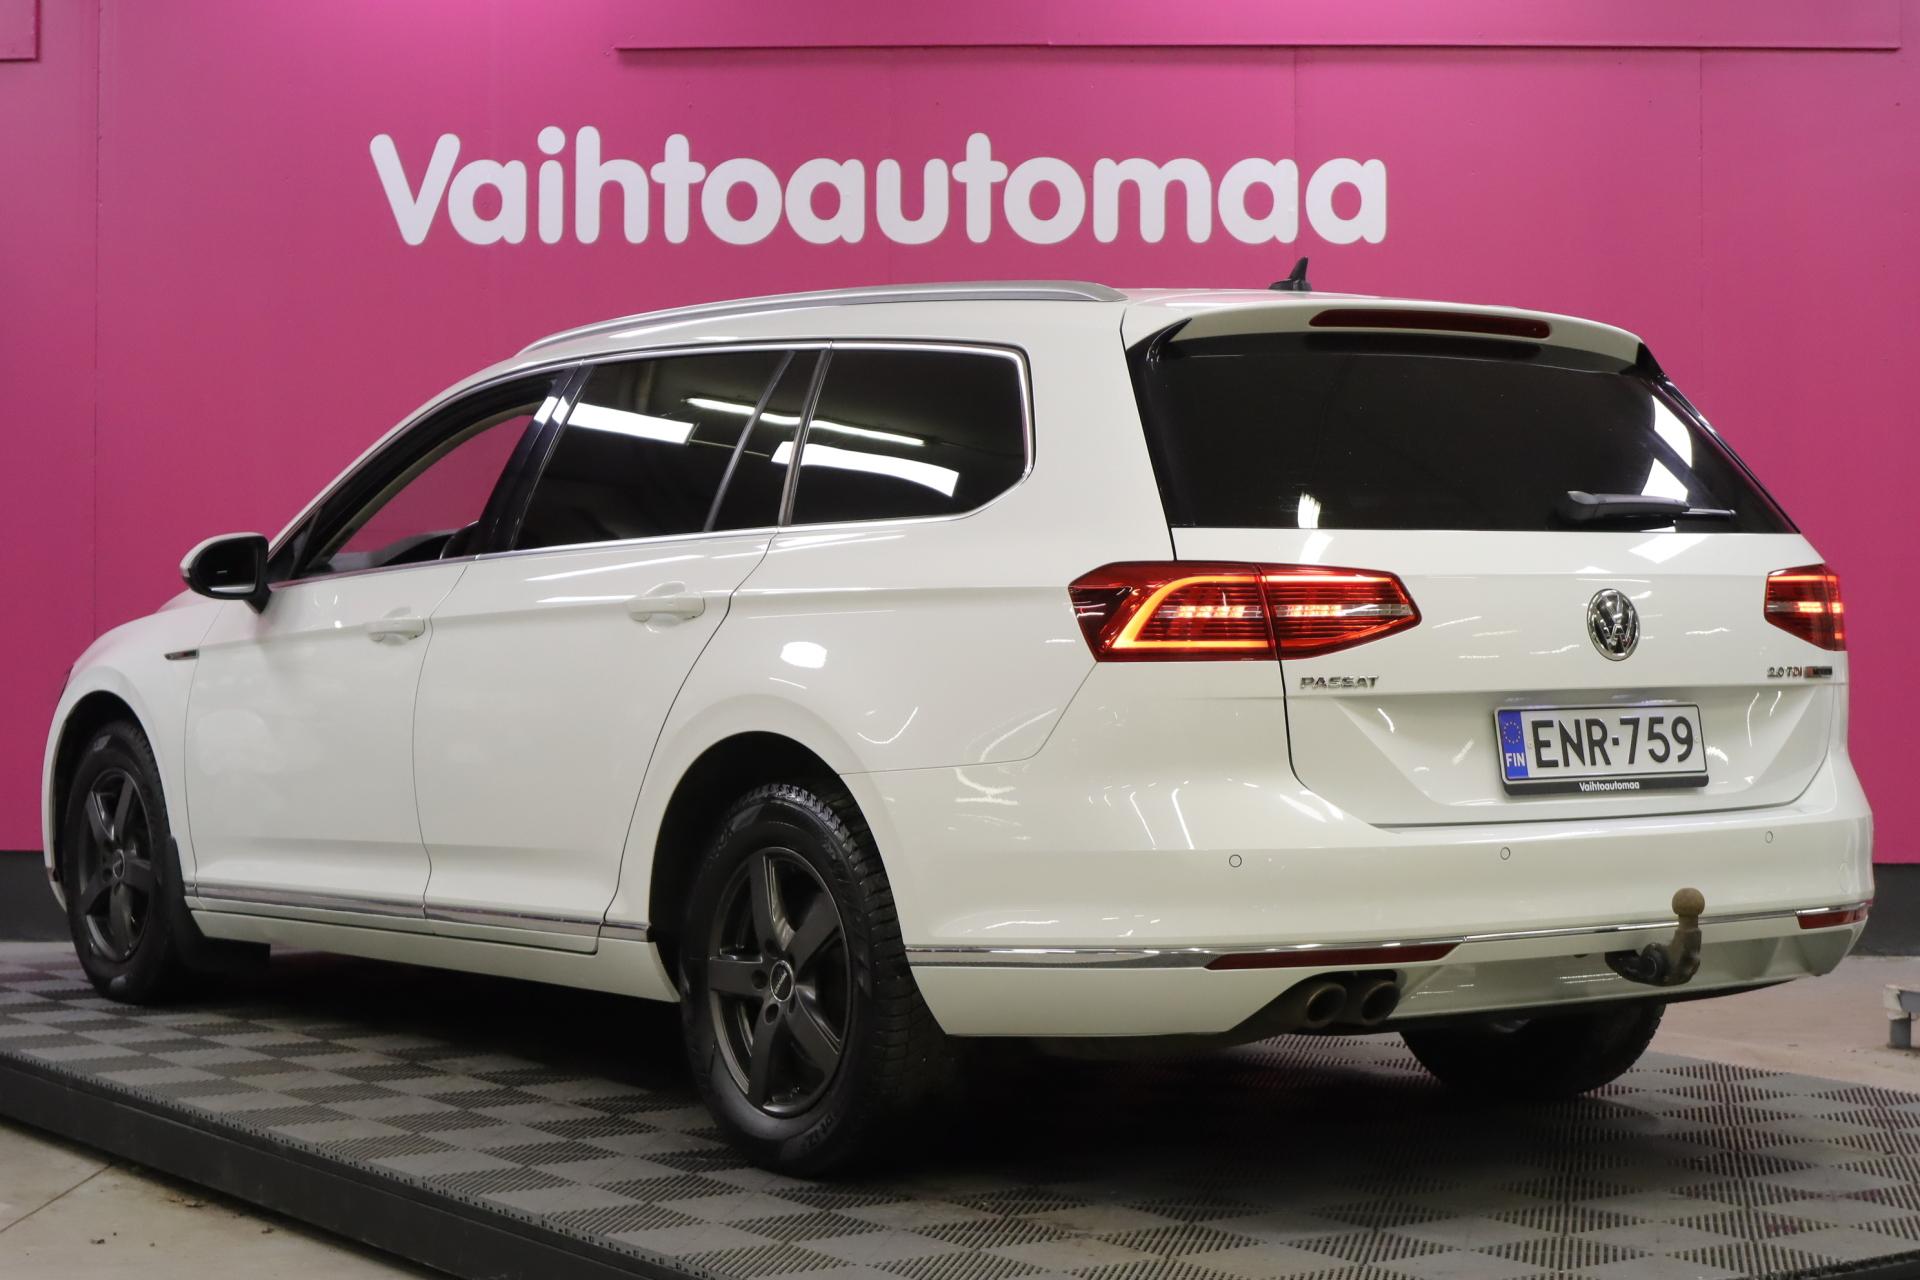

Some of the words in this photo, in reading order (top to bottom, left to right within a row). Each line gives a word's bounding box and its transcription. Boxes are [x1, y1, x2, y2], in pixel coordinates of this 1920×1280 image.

[370, 125, 1388, 246] Vaihtoautomaa
[1786, 666, 1803, 678] TDI
[1300, 676, 1380, 689] PASSAT
[1505, 752, 1526, 768] FIN
[1531, 716, 1694, 768] ENR-759
[1579, 780, 1640, 792] Vaihtoautomaa
